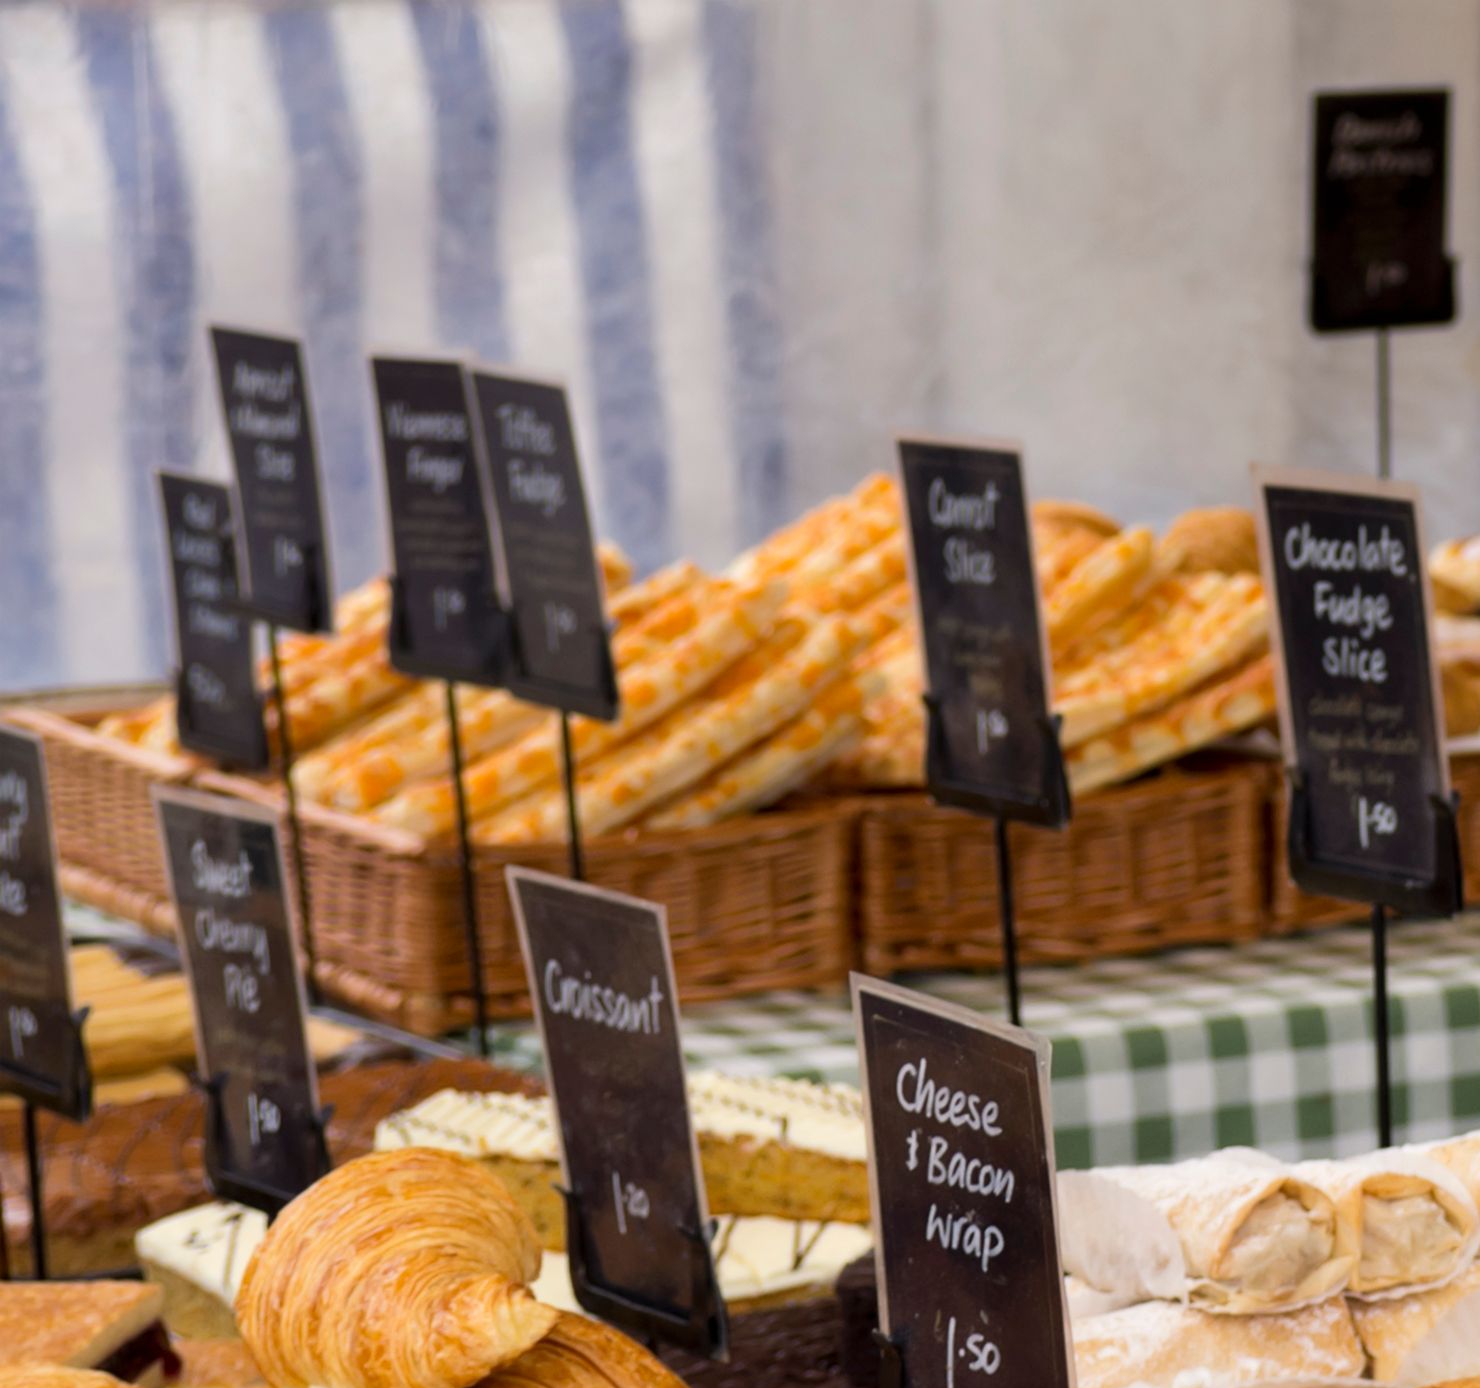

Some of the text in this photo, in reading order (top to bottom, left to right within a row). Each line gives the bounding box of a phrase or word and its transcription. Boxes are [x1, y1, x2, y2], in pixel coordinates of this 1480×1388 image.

[928, 479, 1000, 530] Carrot
[944, 541, 995, 585] Slice
[1285, 525, 1406, 576] Chocolate
[1314, 582, 1393, 639] Fudge
[1323, 638, 1388, 683] Slice
[190, 840, 253, 898] Sweet
[195, 908, 270, 974] Cherry
[223, 962, 260, 1013] Pie
[544, 958, 663, 1035] Croissant
[896, 1057, 1002, 1136] Cheese
[925, 1135, 1015, 1204] Bacon
